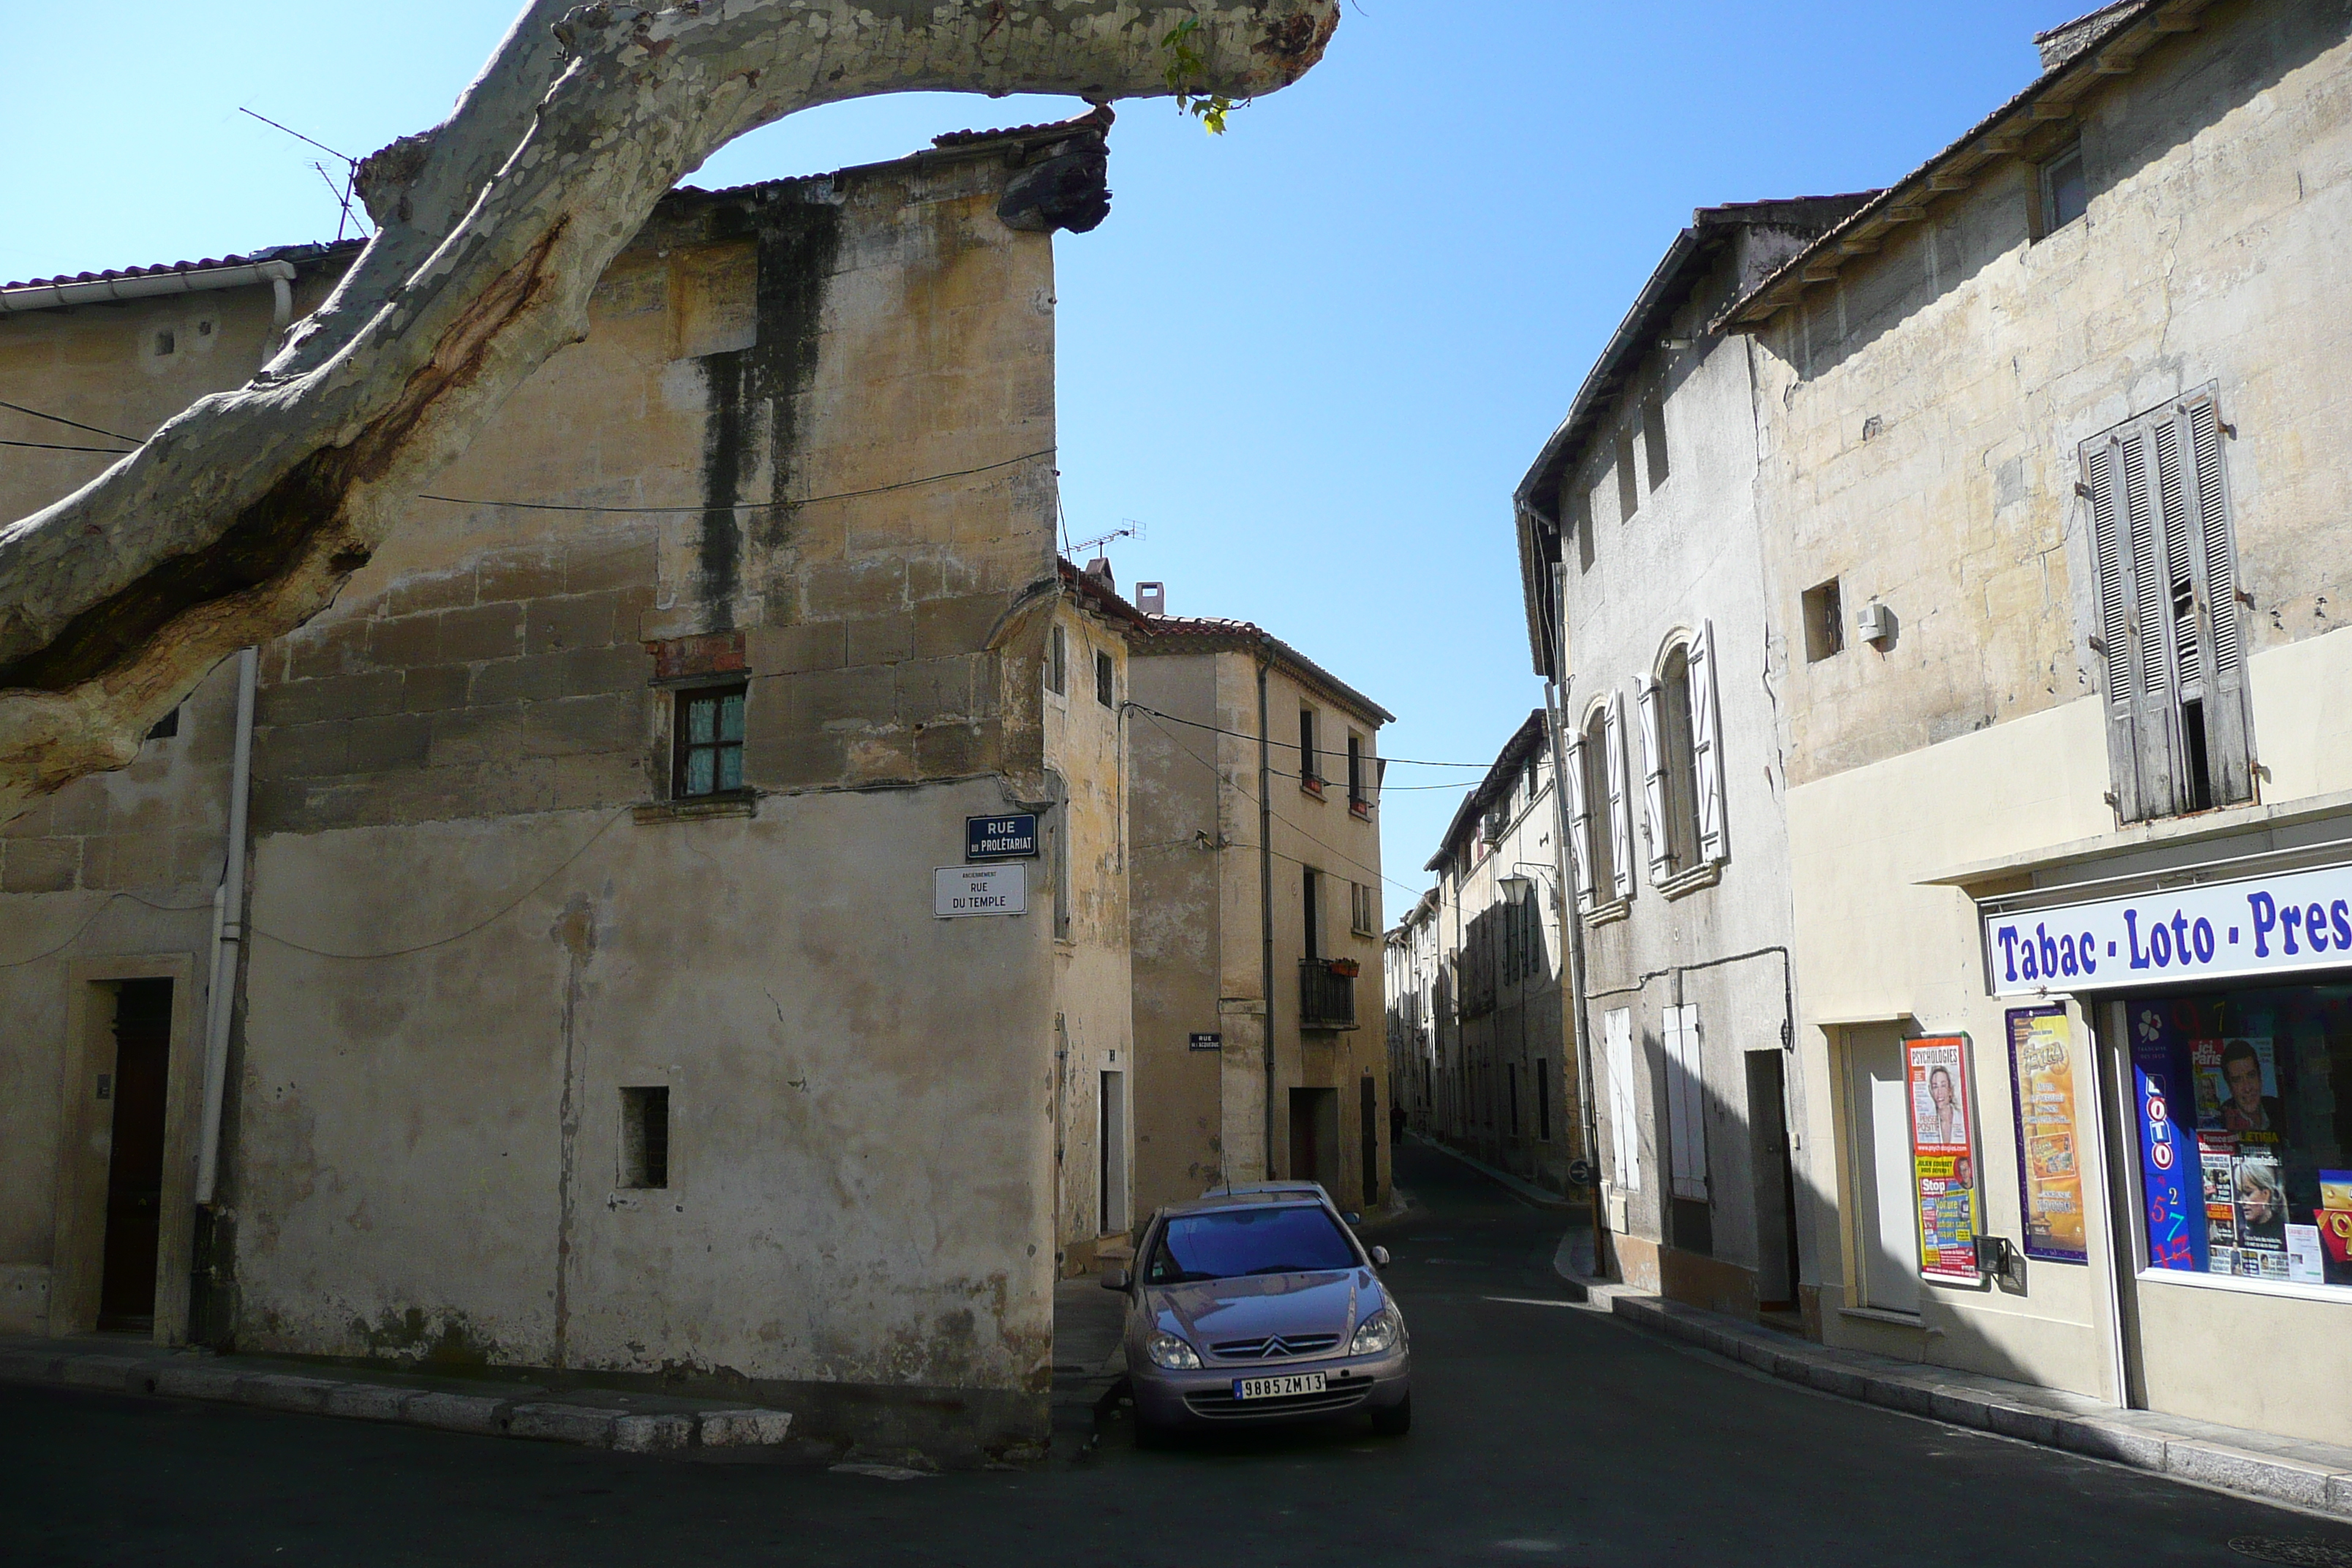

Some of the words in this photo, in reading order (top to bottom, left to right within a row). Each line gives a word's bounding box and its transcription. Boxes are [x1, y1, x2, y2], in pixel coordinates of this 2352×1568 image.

[988, 821, 1015, 834] RUE
[981, 837, 1032, 852] PROLÉTARIAT
[970, 882, 987, 892] RUE
[953, 898, 965, 908] DU
[968, 896, 1006, 908] TEMPLE
[1998, 922, 2096, 982] Tabac
[2123, 908, 2215, 970] Loto
[2247, 891, 2352, 958] Pres
[1912, 1048, 1957, 1065] PSYCHOLOGIES
[2193, 1051, 2222, 1065] Paris
[2147, 1075, 2172, 1168] LOTO
[2198, 1142, 2234, 1150] Dimanche
[1922, 1178, 1945, 1194] Stop
[1934, 1198, 1958, 1209] Voiture
[2168, 1187, 2179, 1205] 2
[2151, 1195, 2166, 1223] 5
[2166, 1211, 2185, 1241] 7
[1245, 1379, 1280, 1396] 9885
[1285, 1377, 1302, 1392] ZM
[1306, 1375, 1322, 1391] 13
